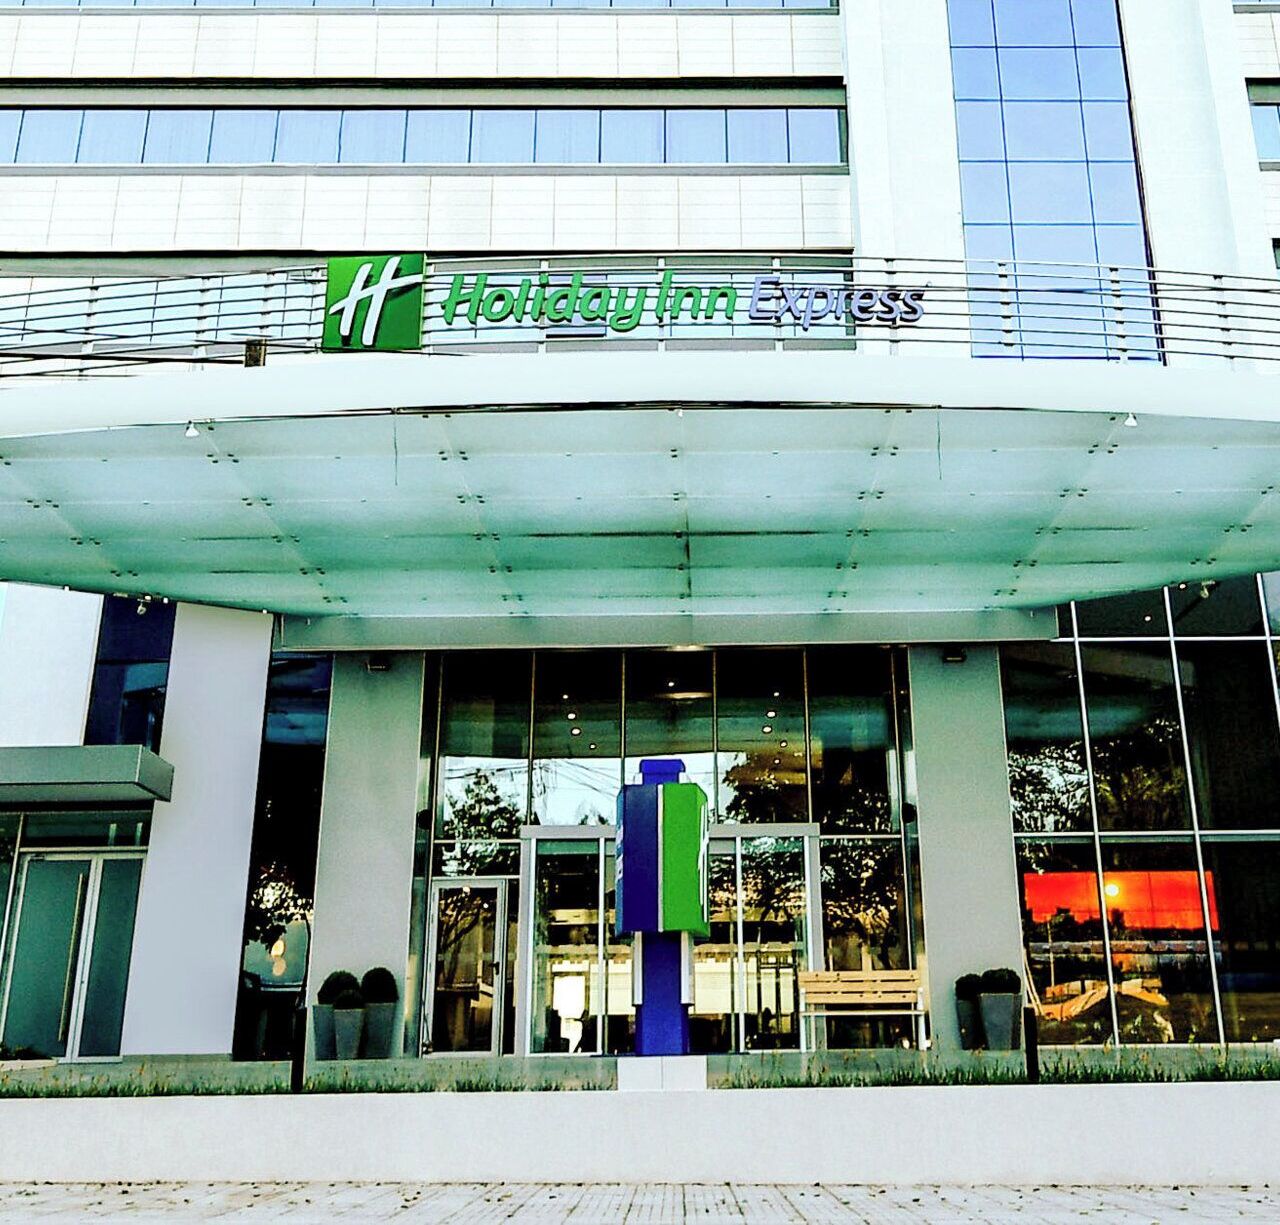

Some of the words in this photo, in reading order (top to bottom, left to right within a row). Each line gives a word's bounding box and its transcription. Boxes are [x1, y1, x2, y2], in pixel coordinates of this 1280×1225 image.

[440, 270, 648, 332] Holiday
[653, 269, 738, 322] Inn
[747, 276, 925, 332] Express
